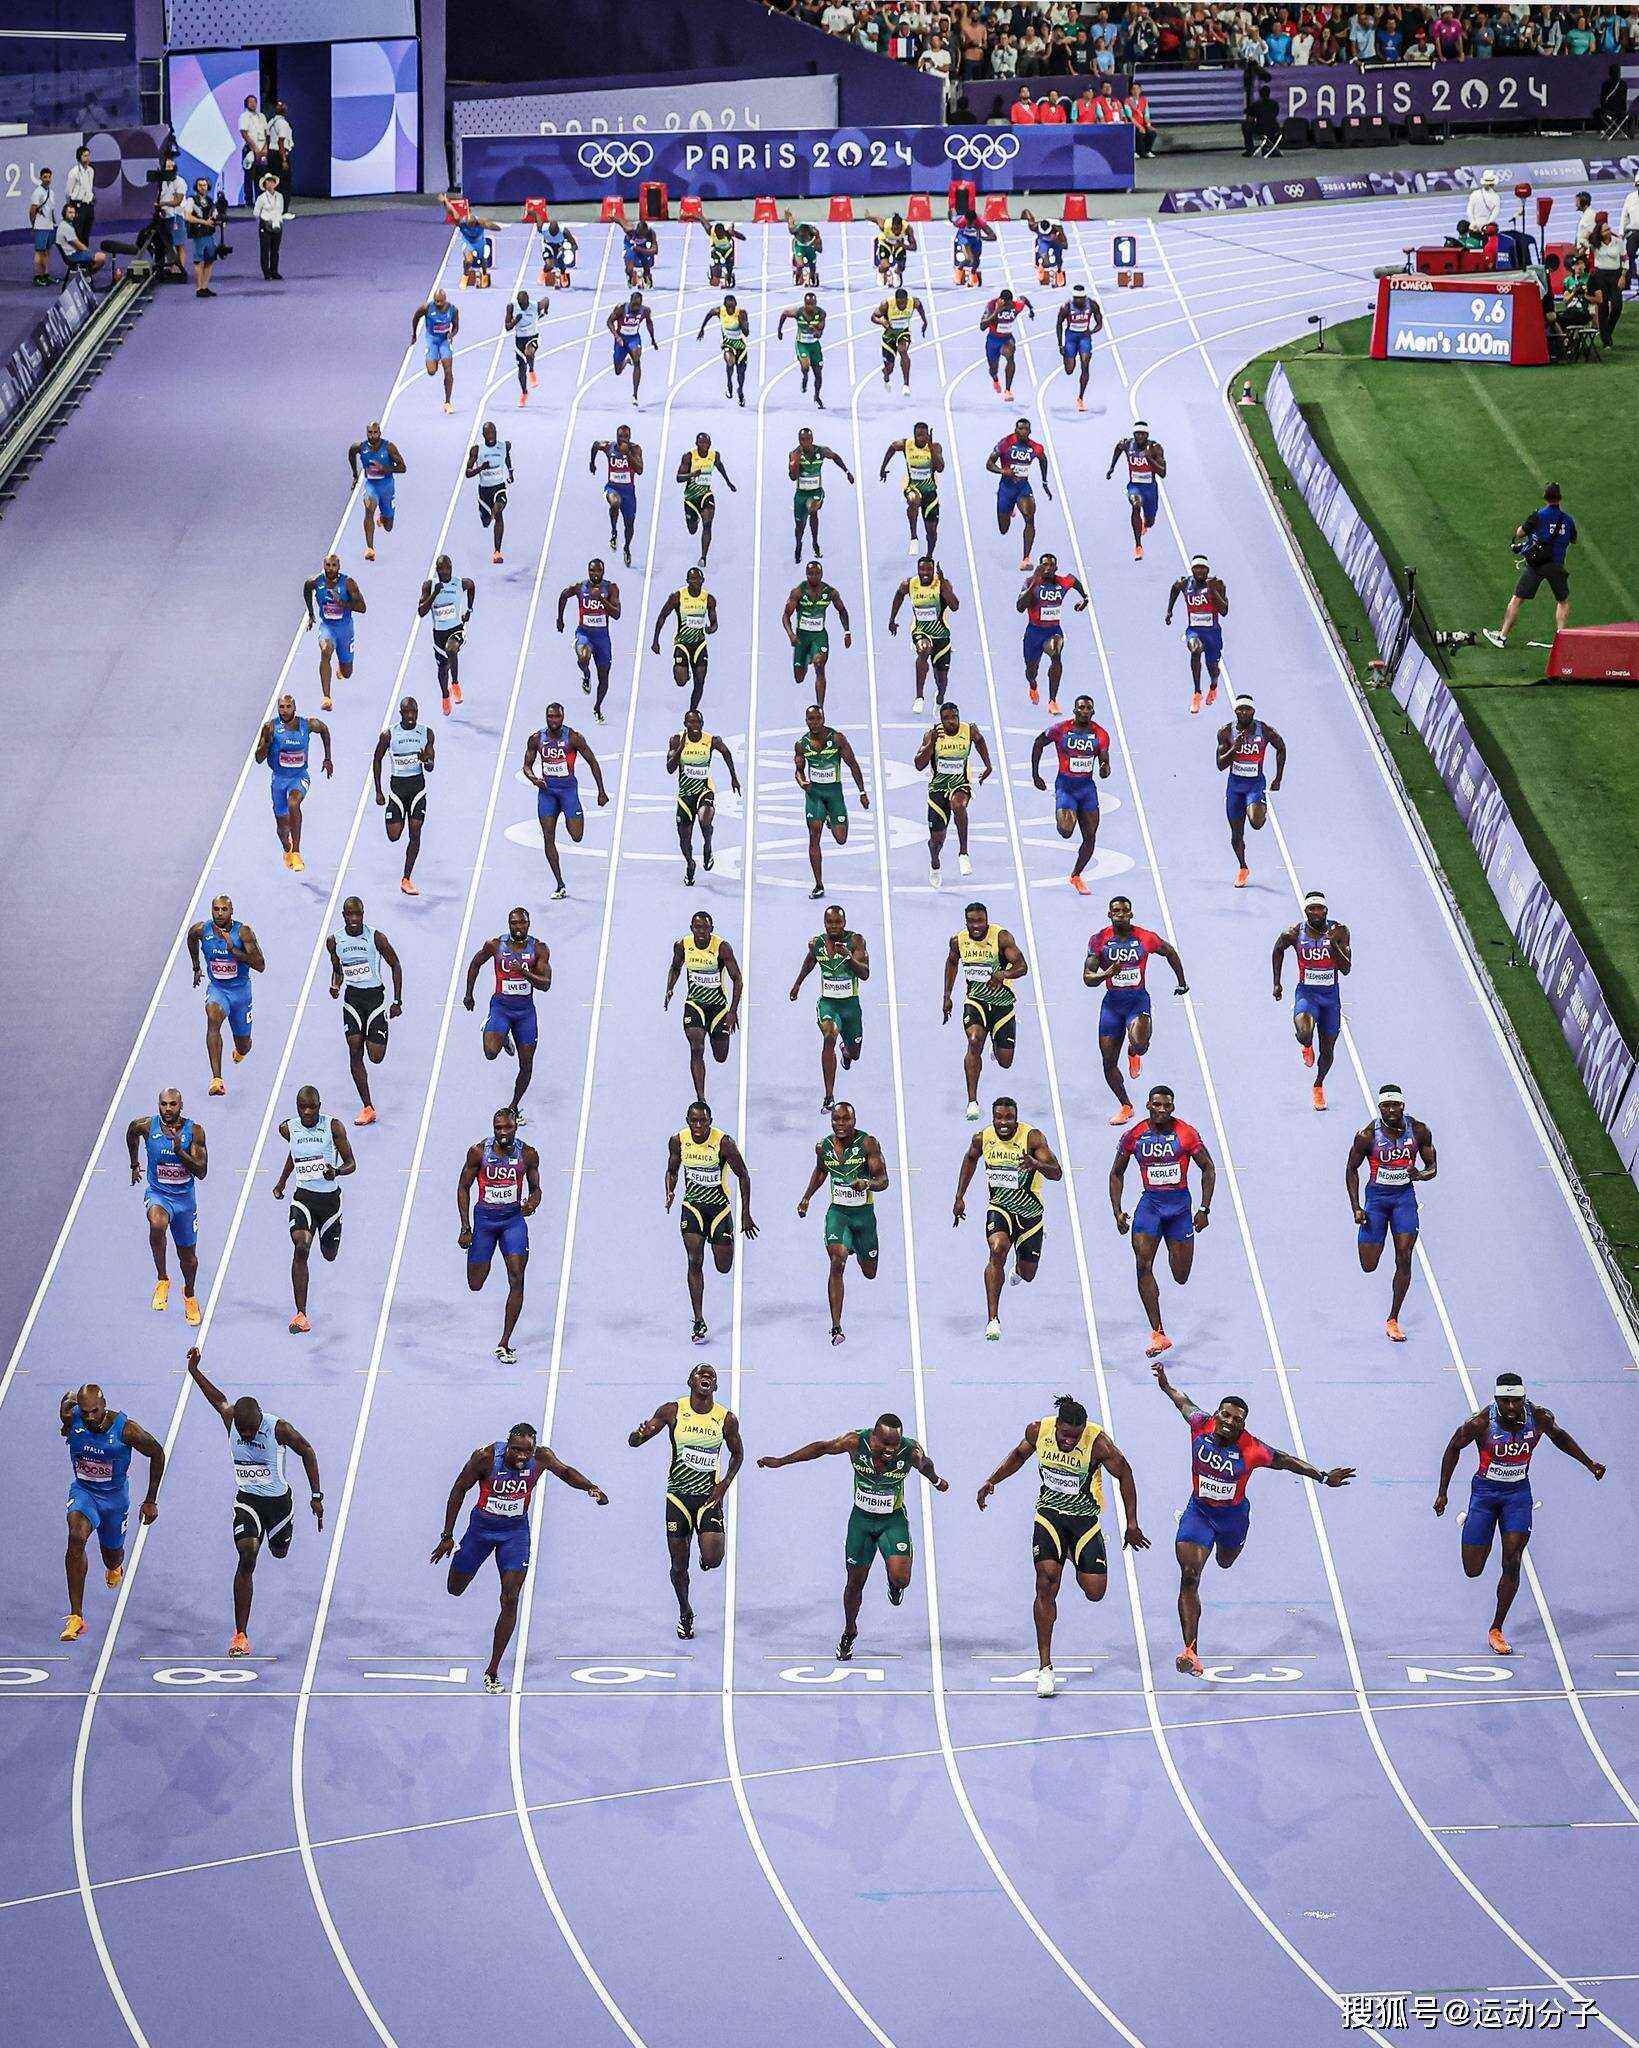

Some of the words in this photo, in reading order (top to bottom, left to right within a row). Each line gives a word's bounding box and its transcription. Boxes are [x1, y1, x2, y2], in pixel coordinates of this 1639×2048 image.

[1431, 77, 1548, 111] 2024
[812, 141, 912, 168] 2024
[1400, 281, 1434, 291] OMEGA
[1471, 298, 1506, 324] 9.6
[1395, 330, 1451, 353] Men's
[1456, 332, 1510, 356] 100m
[1010, 450, 1031, 461] USA
[1040, 589, 1062, 601] USA
[1187, 595, 1208, 606] USA
[1067, 738, 1094, 751] USA
[542, 747, 566, 759] USA
[964, 949, 993, 959] JAMAICA
[1108, 948, 1139, 962] USA
[1302, 948, 1331, 961] USA
[501, 960, 530, 974] UA
[684, 1152, 713, 1162] JAMAICA
[1143, 1143, 1175, 1158] USA
[1379, 1147, 1411, 1163] USA
[486, 1166, 517, 1181] USA
[1149, 1168, 1179, 1179] KERLEY
[682, 1424, 718, 1438] JAMAICA
[1494, 1442, 1530, 1458] USA
[683, 1451, 716, 1467] SEVILLE
[1040, 1450, 1082, 1469] JAMAICA
[1197, 1444, 1234, 1477] USA
[493, 1480, 528, 1495] USA
[1199, 1479, 1234, 1495] KERLEY
[152, 1667, 259, 1685] 8
[363, 1667, 469, 1684] 7
[570, 1666, 678, 1684] 6
[778, 1666, 886, 1684] 5
[1198, 1666, 1304, 1683] 3
[1405, 1666, 1514, 1683] 2
